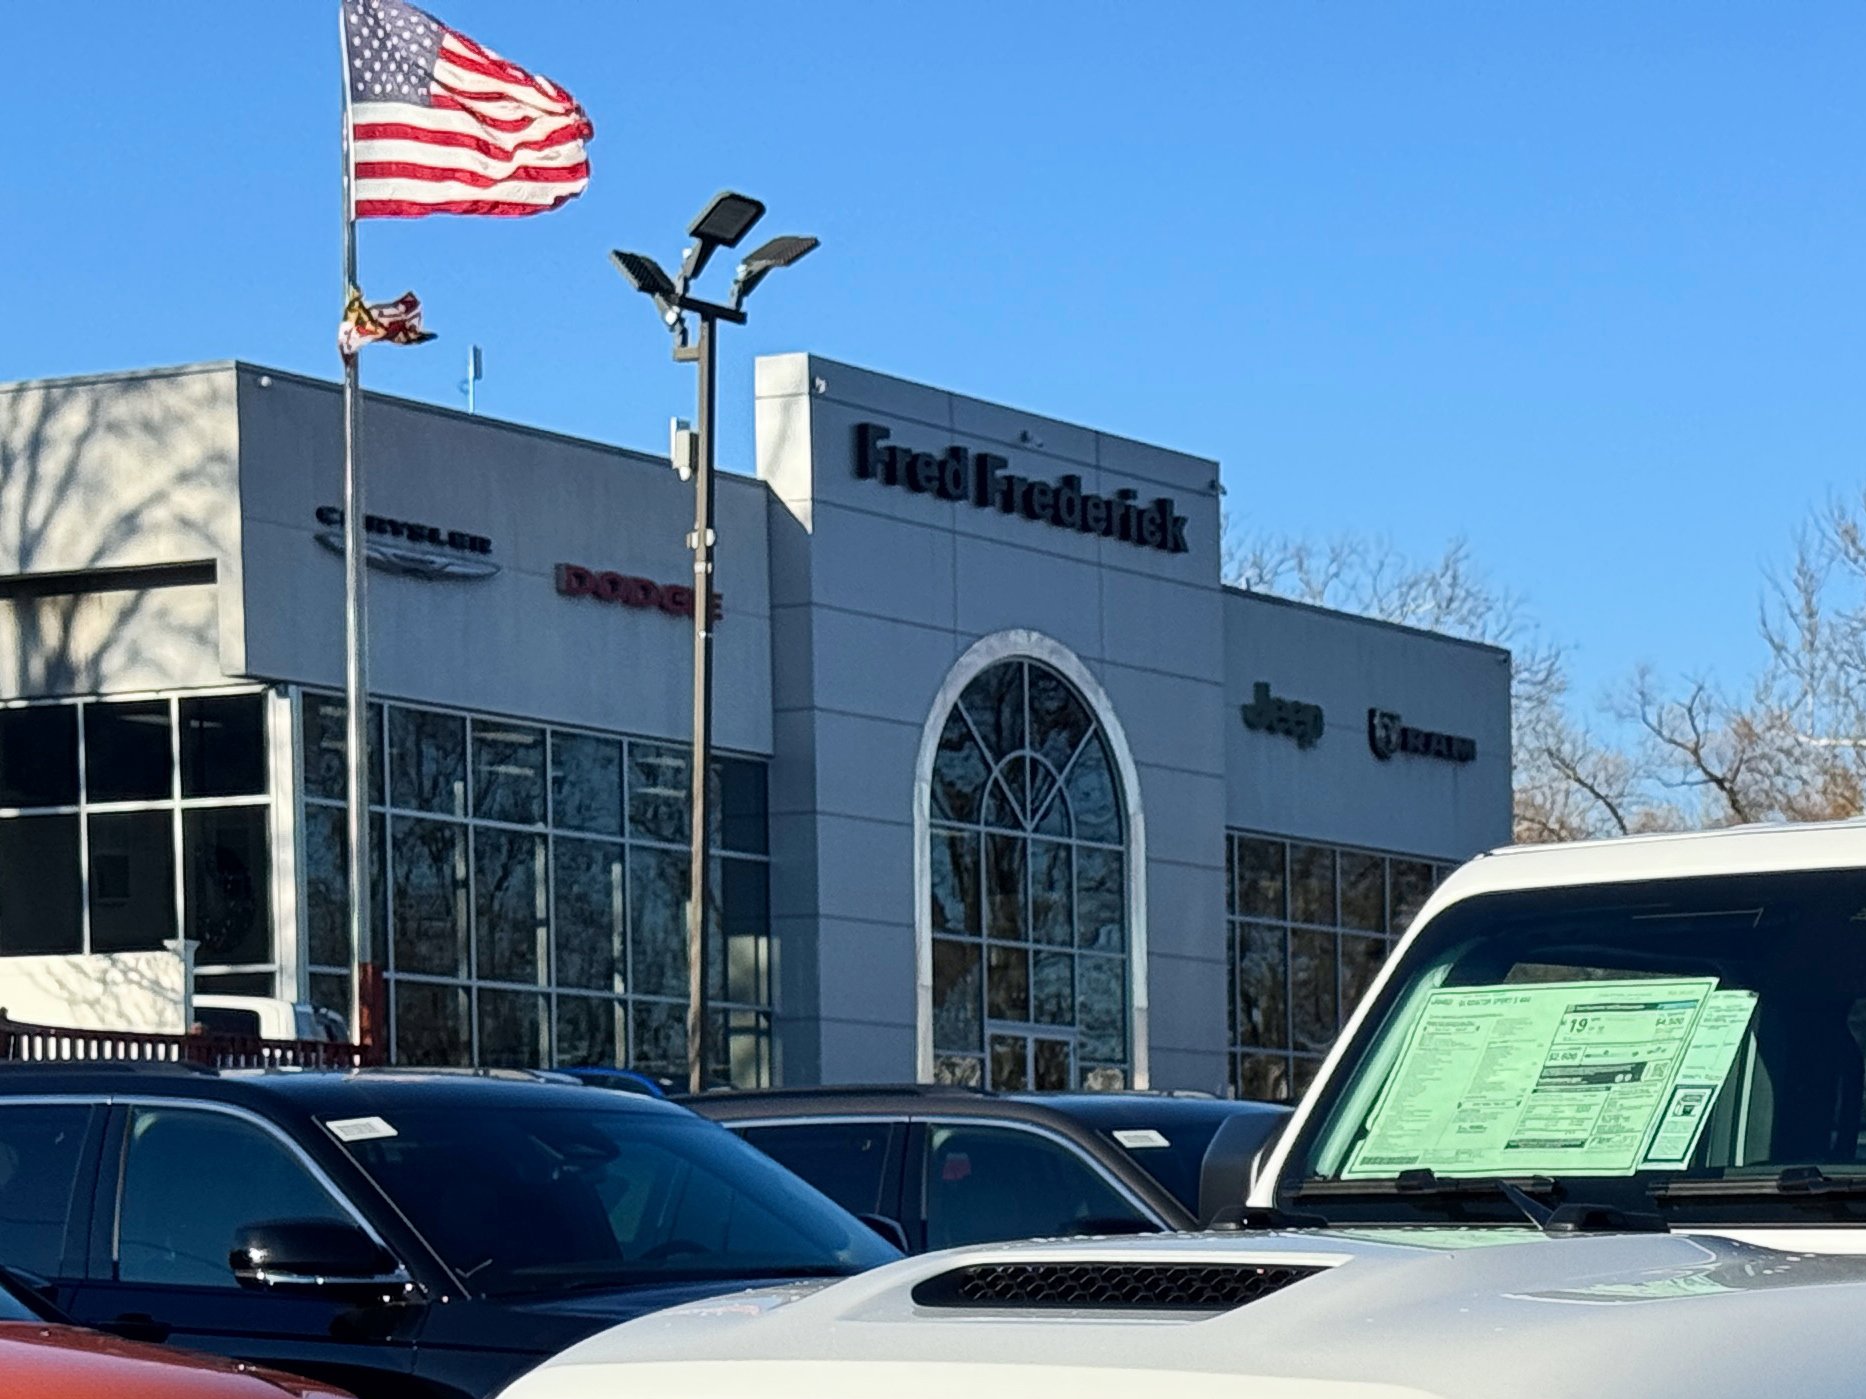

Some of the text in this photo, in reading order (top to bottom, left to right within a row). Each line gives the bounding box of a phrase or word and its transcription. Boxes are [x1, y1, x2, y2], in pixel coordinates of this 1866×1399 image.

[853, 423, 1189, 553] Fred Frederick
[315, 505, 493, 554] CRYSLER
[1241, 682, 1324, 751] Jeep
[1401, 727, 1477, 762] RAM
